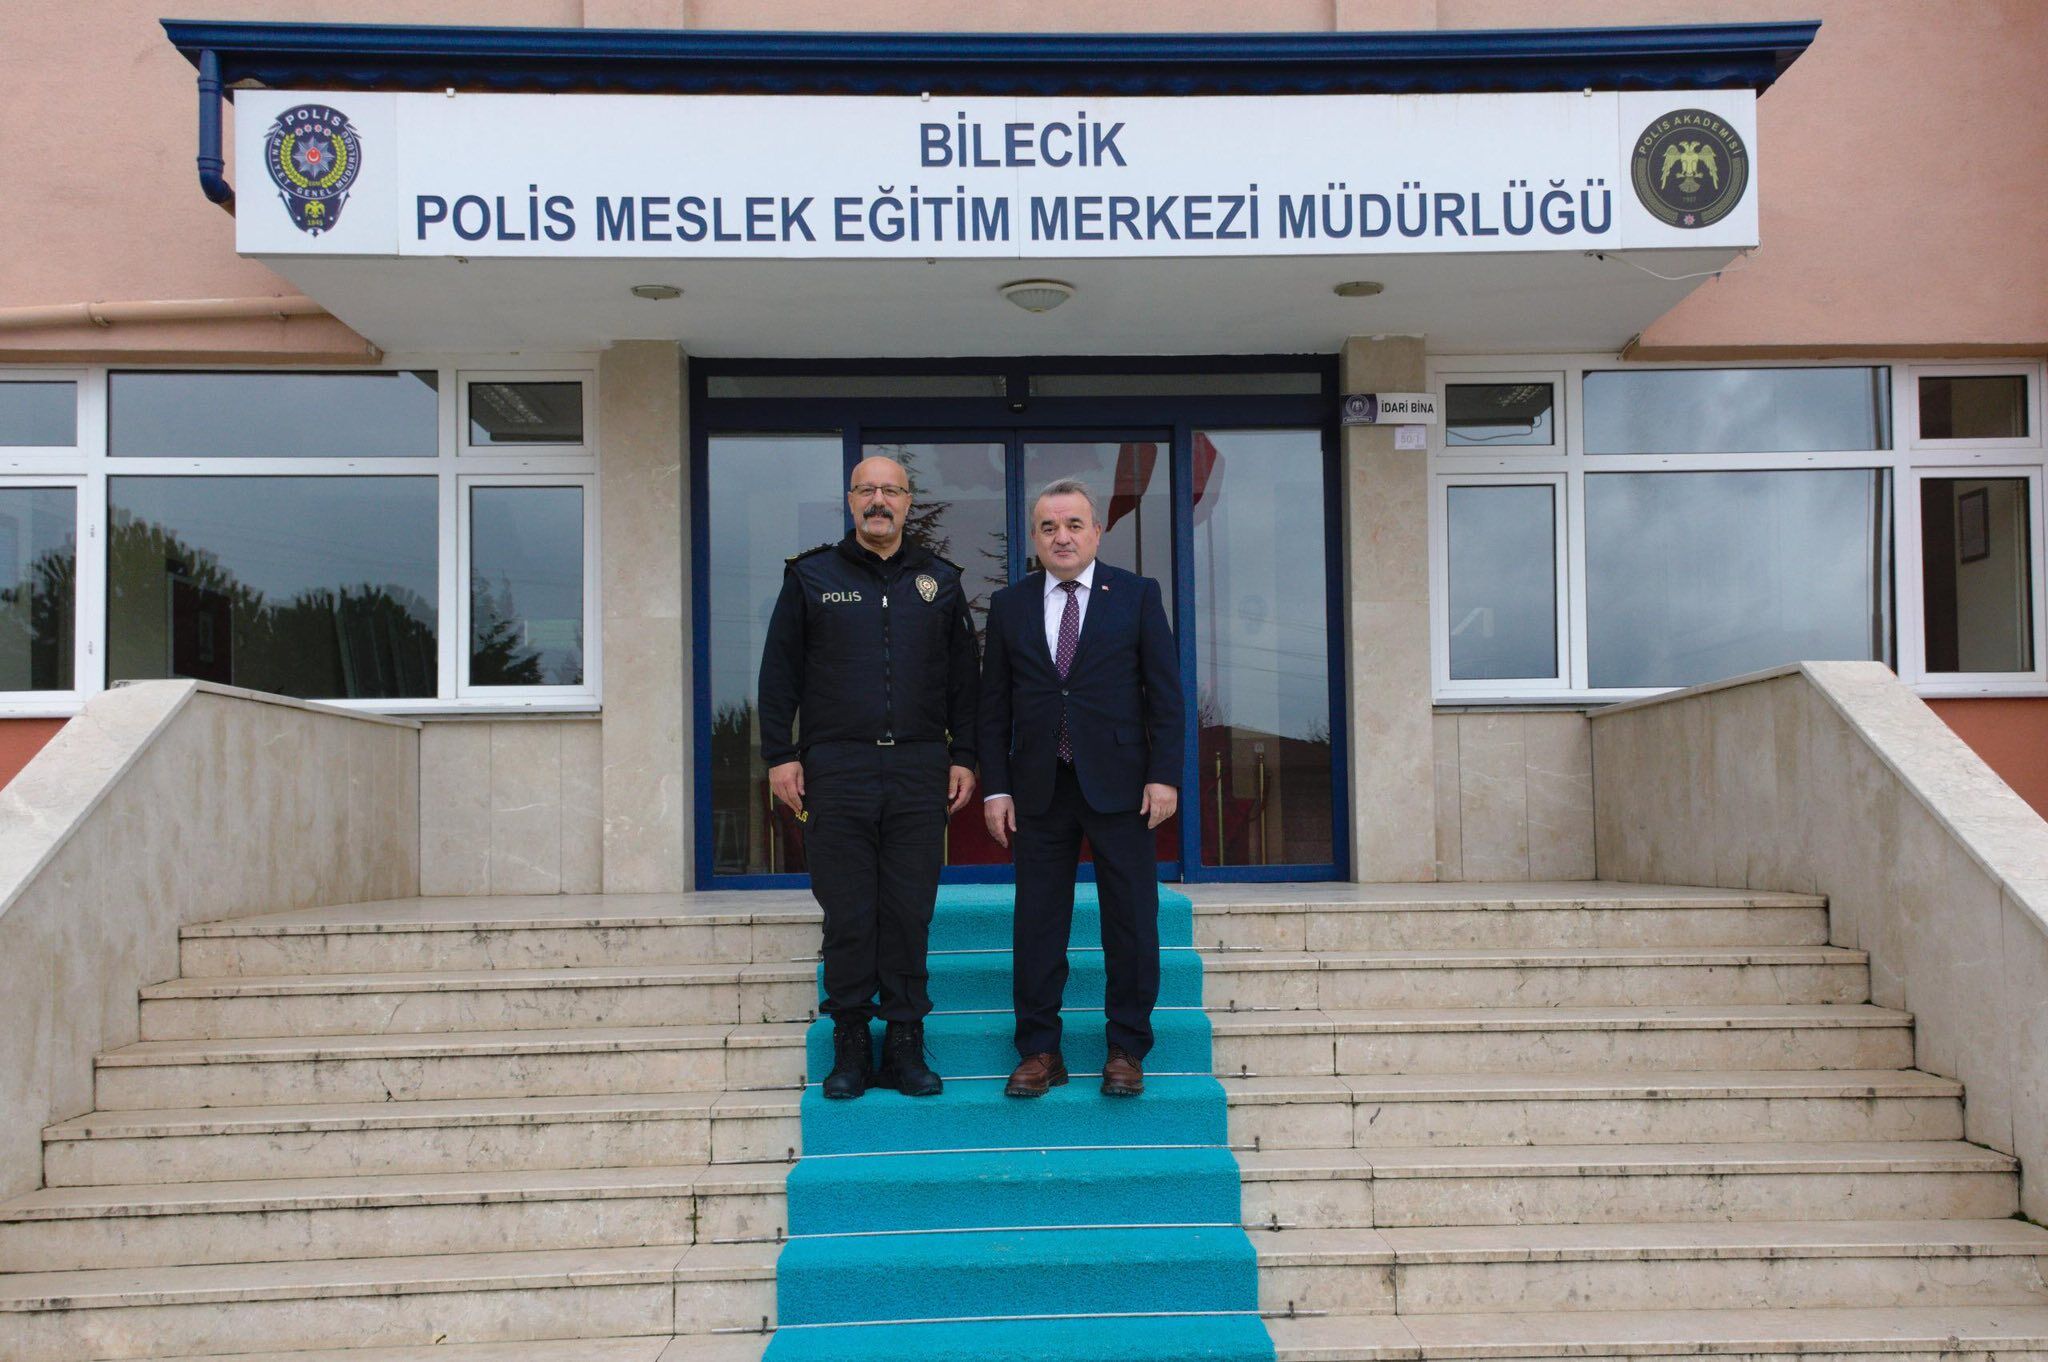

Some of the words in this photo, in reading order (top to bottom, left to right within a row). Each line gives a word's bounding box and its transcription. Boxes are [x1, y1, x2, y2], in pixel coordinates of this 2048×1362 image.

[285, 109, 341, 126] POLİS
[921, 111, 1126, 167] BİLECİK
[1638, 119, 1670, 154] POLİS
[416, 184, 576, 242] POLİS
[597, 196, 816, 242] MESLEK
[834, 184, 1009, 242] EĞİTİM
[1030, 183, 1259, 241] MERKEZİ
[1278, 178, 1611, 240] MÜDÜRLÜĞÜ
[1381, 399, 1408, 413] İDARİ
[1411, 399, 1434, 413] BİNA
